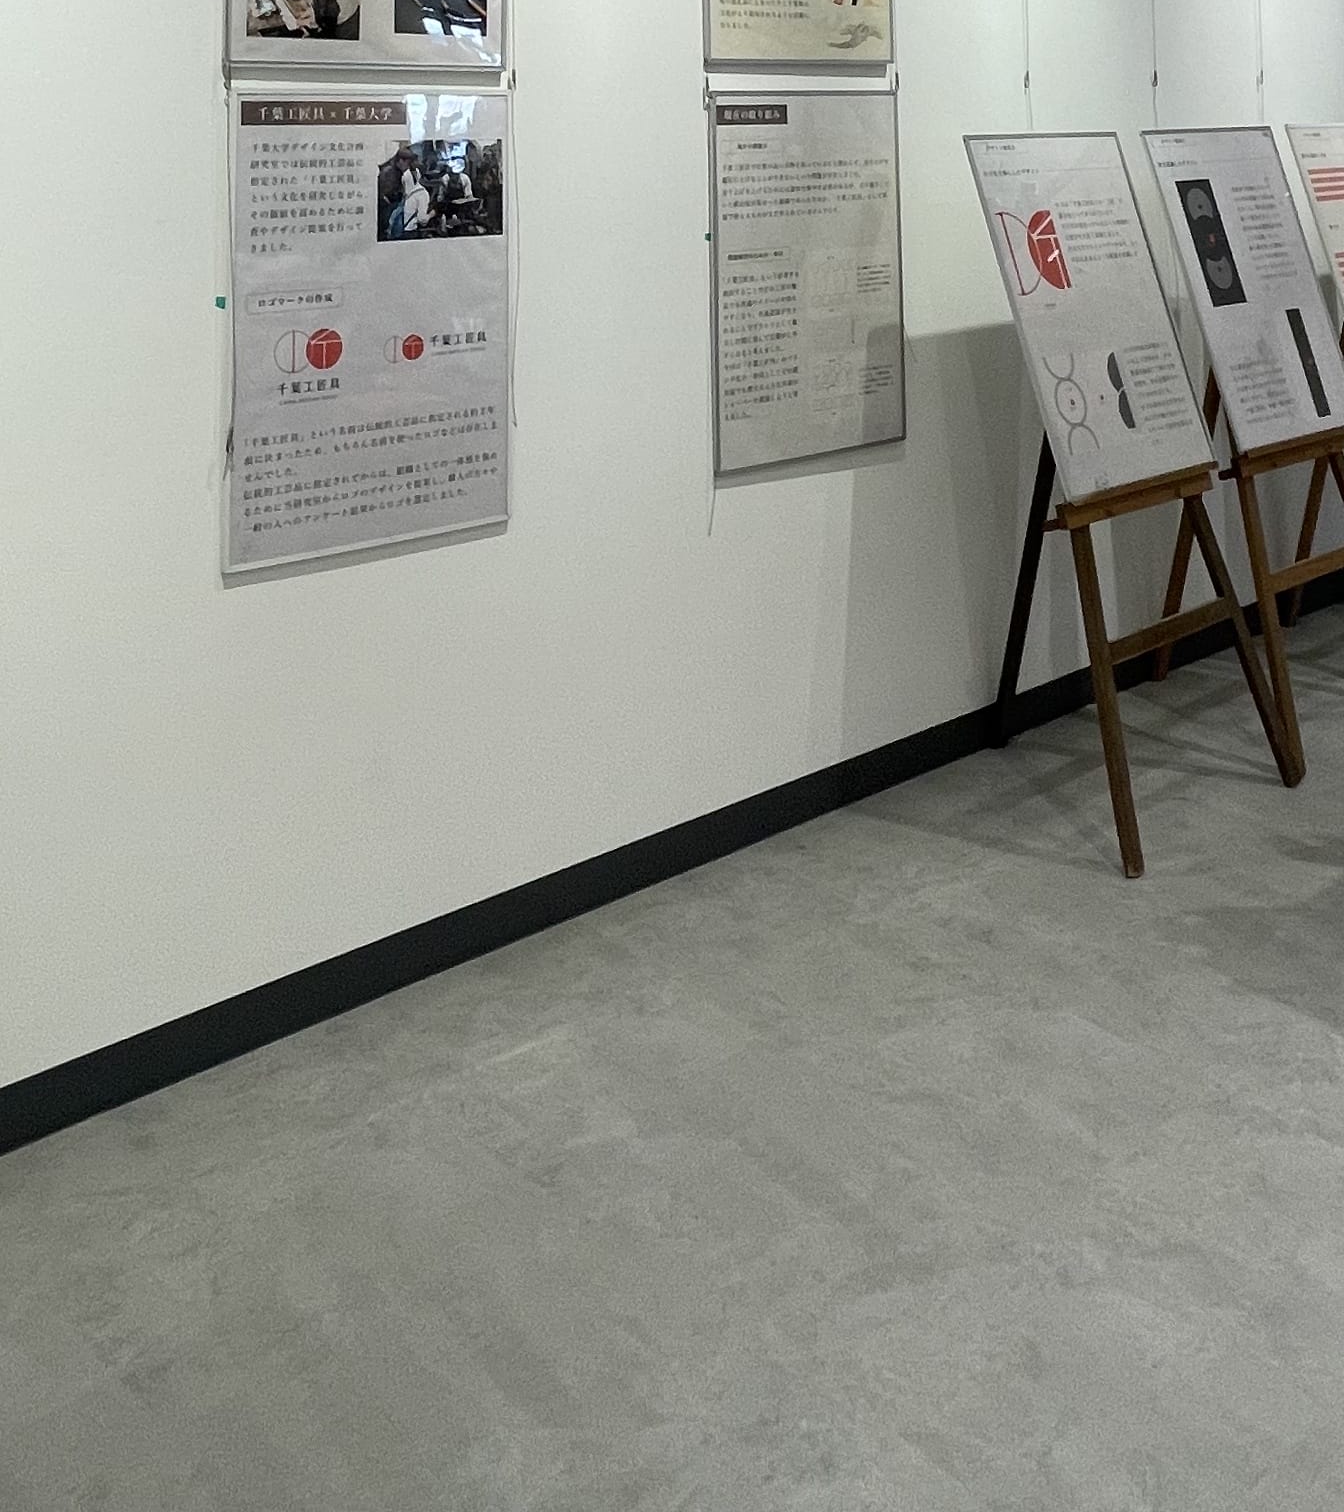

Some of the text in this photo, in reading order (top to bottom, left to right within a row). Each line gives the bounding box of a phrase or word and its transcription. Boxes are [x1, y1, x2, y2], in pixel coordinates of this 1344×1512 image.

[258, 106, 324, 121] 千葉工匠具
[344, 106, 392, 120] 千葉大学
[429, 330, 486, 348] 千葉工匠具
[278, 376, 340, 395] 千葉工匠具
